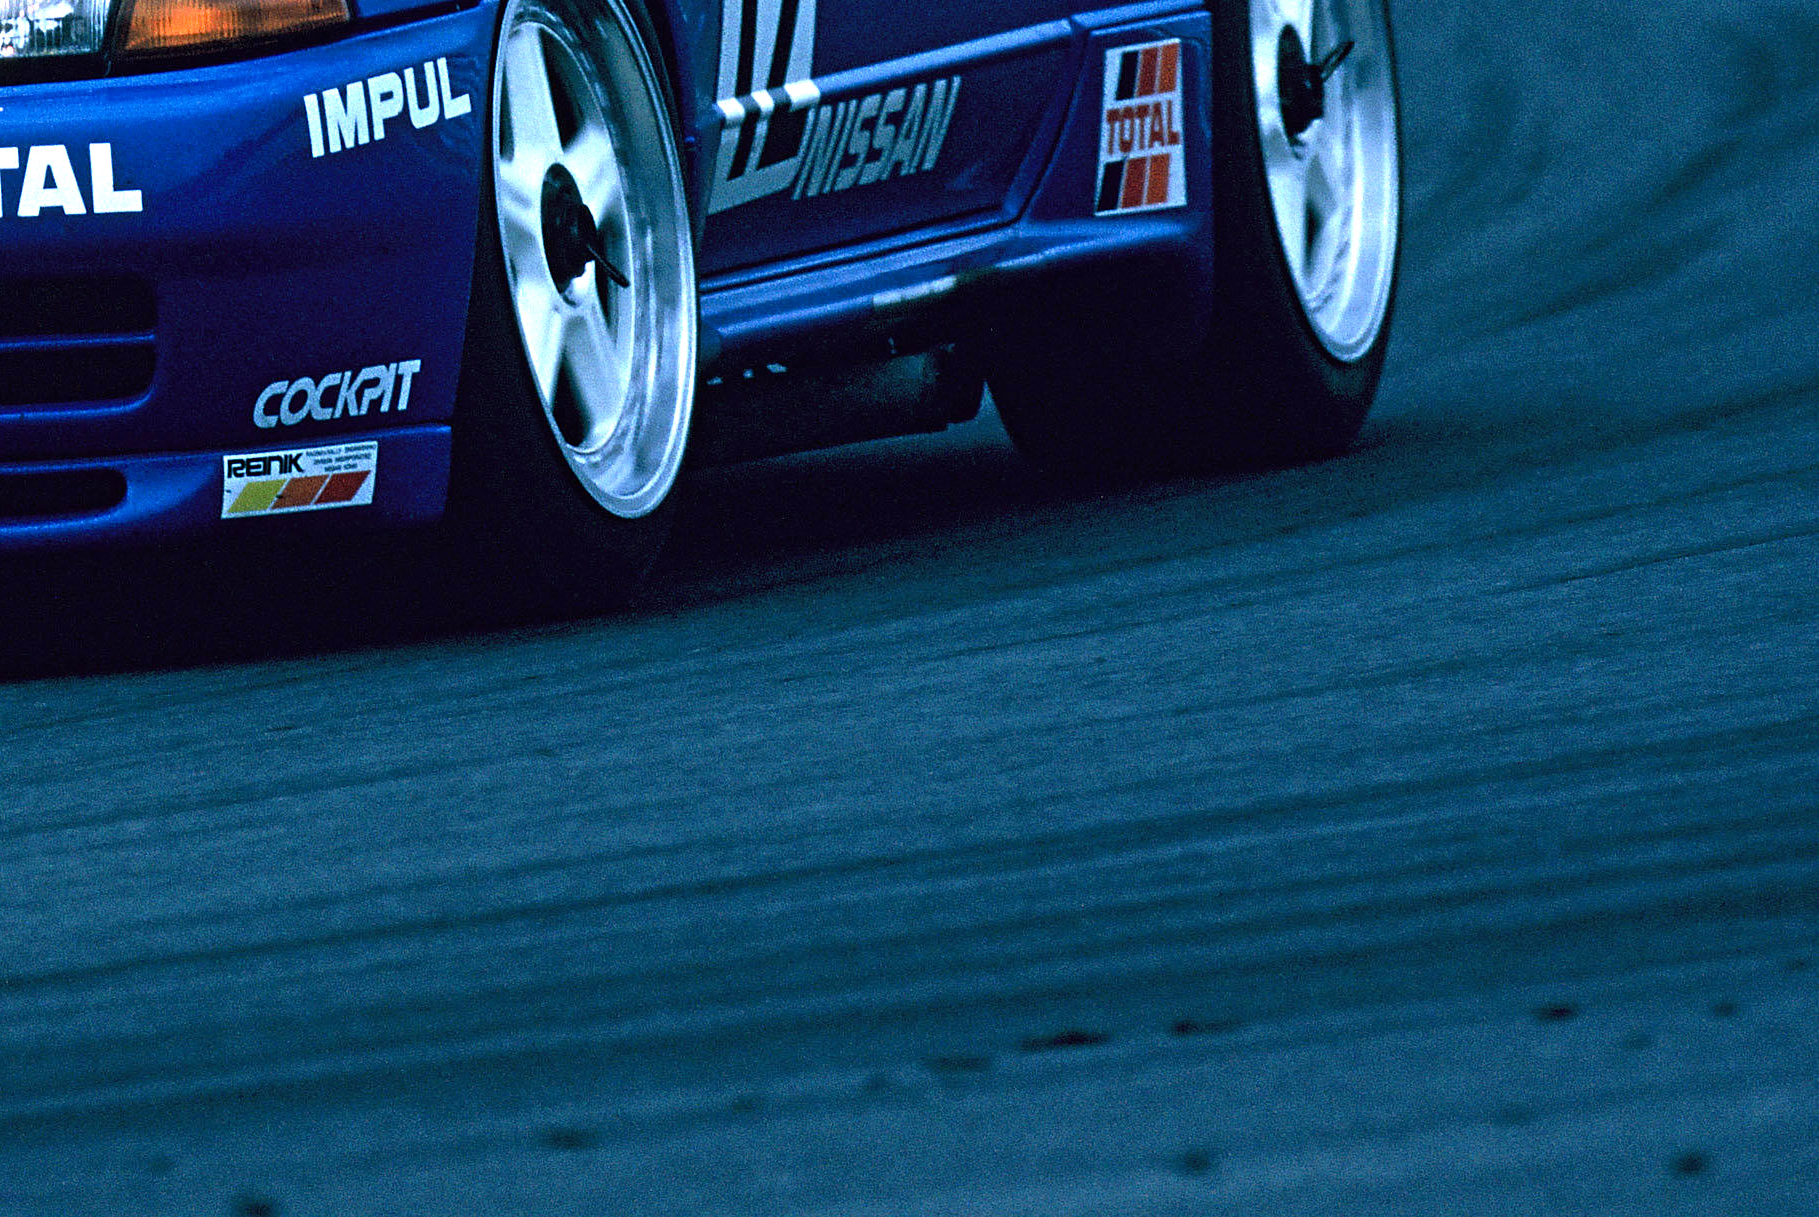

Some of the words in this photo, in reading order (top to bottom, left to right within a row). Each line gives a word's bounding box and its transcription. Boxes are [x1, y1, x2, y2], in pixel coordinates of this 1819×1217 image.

[304, 57, 471, 158] IMPUL
[791, 76, 962, 201] NISSAN
[1105, 101, 1180, 156] TOTAL
[253, 359, 422, 428] COCKPIT
